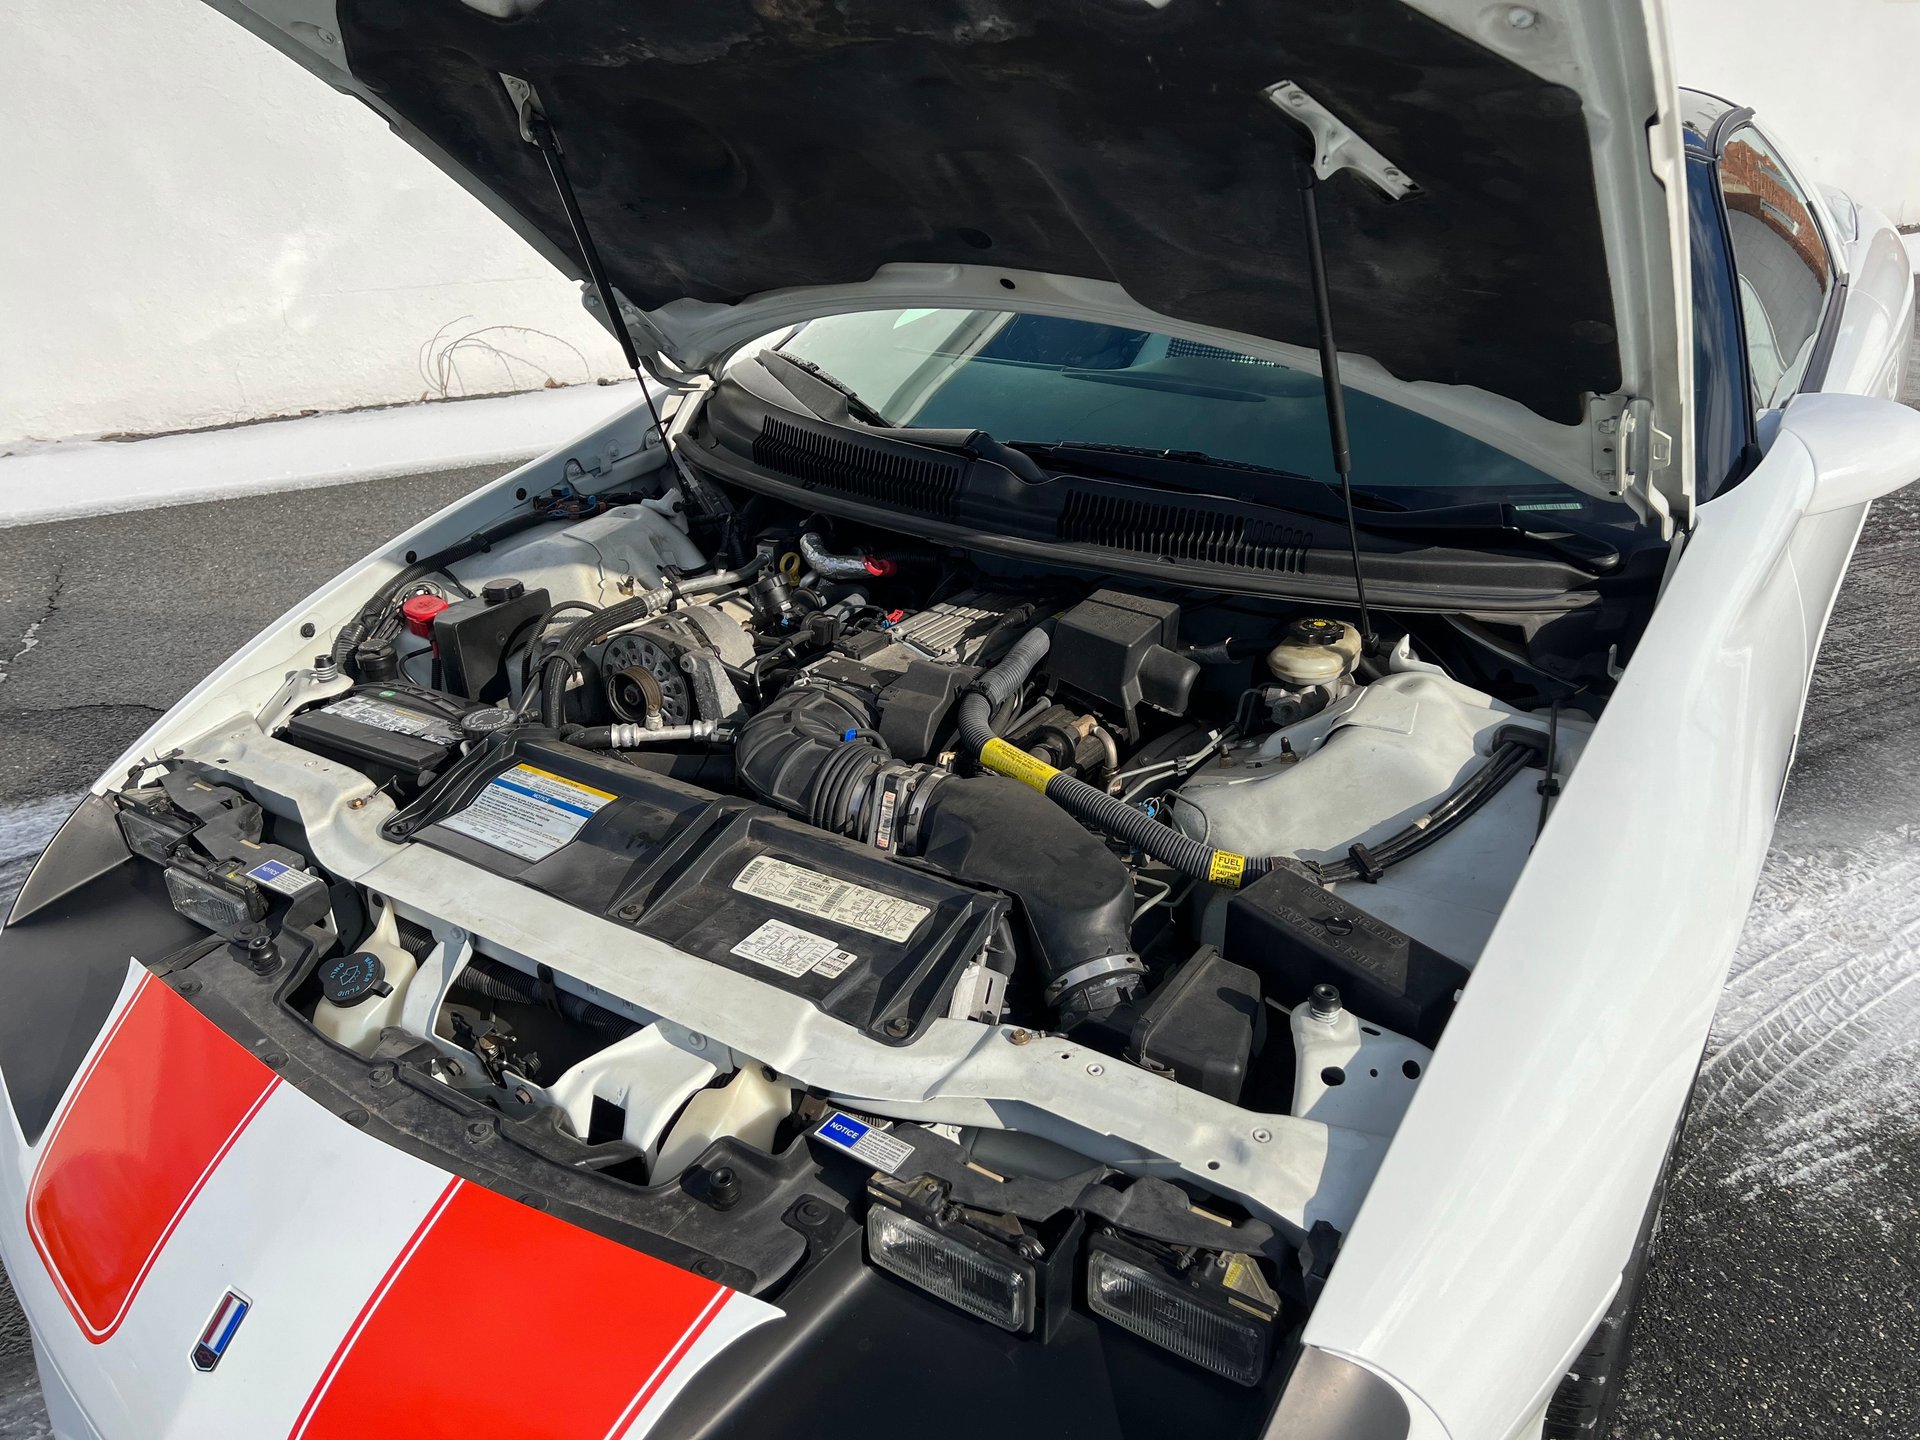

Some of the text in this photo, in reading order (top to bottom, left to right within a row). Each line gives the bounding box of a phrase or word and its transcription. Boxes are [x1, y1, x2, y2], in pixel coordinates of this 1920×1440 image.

[531, 792, 551, 803] NOTICE
[1219, 851, 1243, 860] CAUTION
[1218, 856, 1241, 867] FUEL
[261, 865, 280, 876] NOTICE
[1215, 869, 1240, 879] CAUTION
[808, 880, 833, 892] CATALYST
[1215, 876, 1236, 886] FUEL
[1301, 886, 1405, 945] FUSES RELAYS
[329, 956, 375, 997] WASHER FLUID ONLY
[830, 1121, 860, 1140] NOTICE
